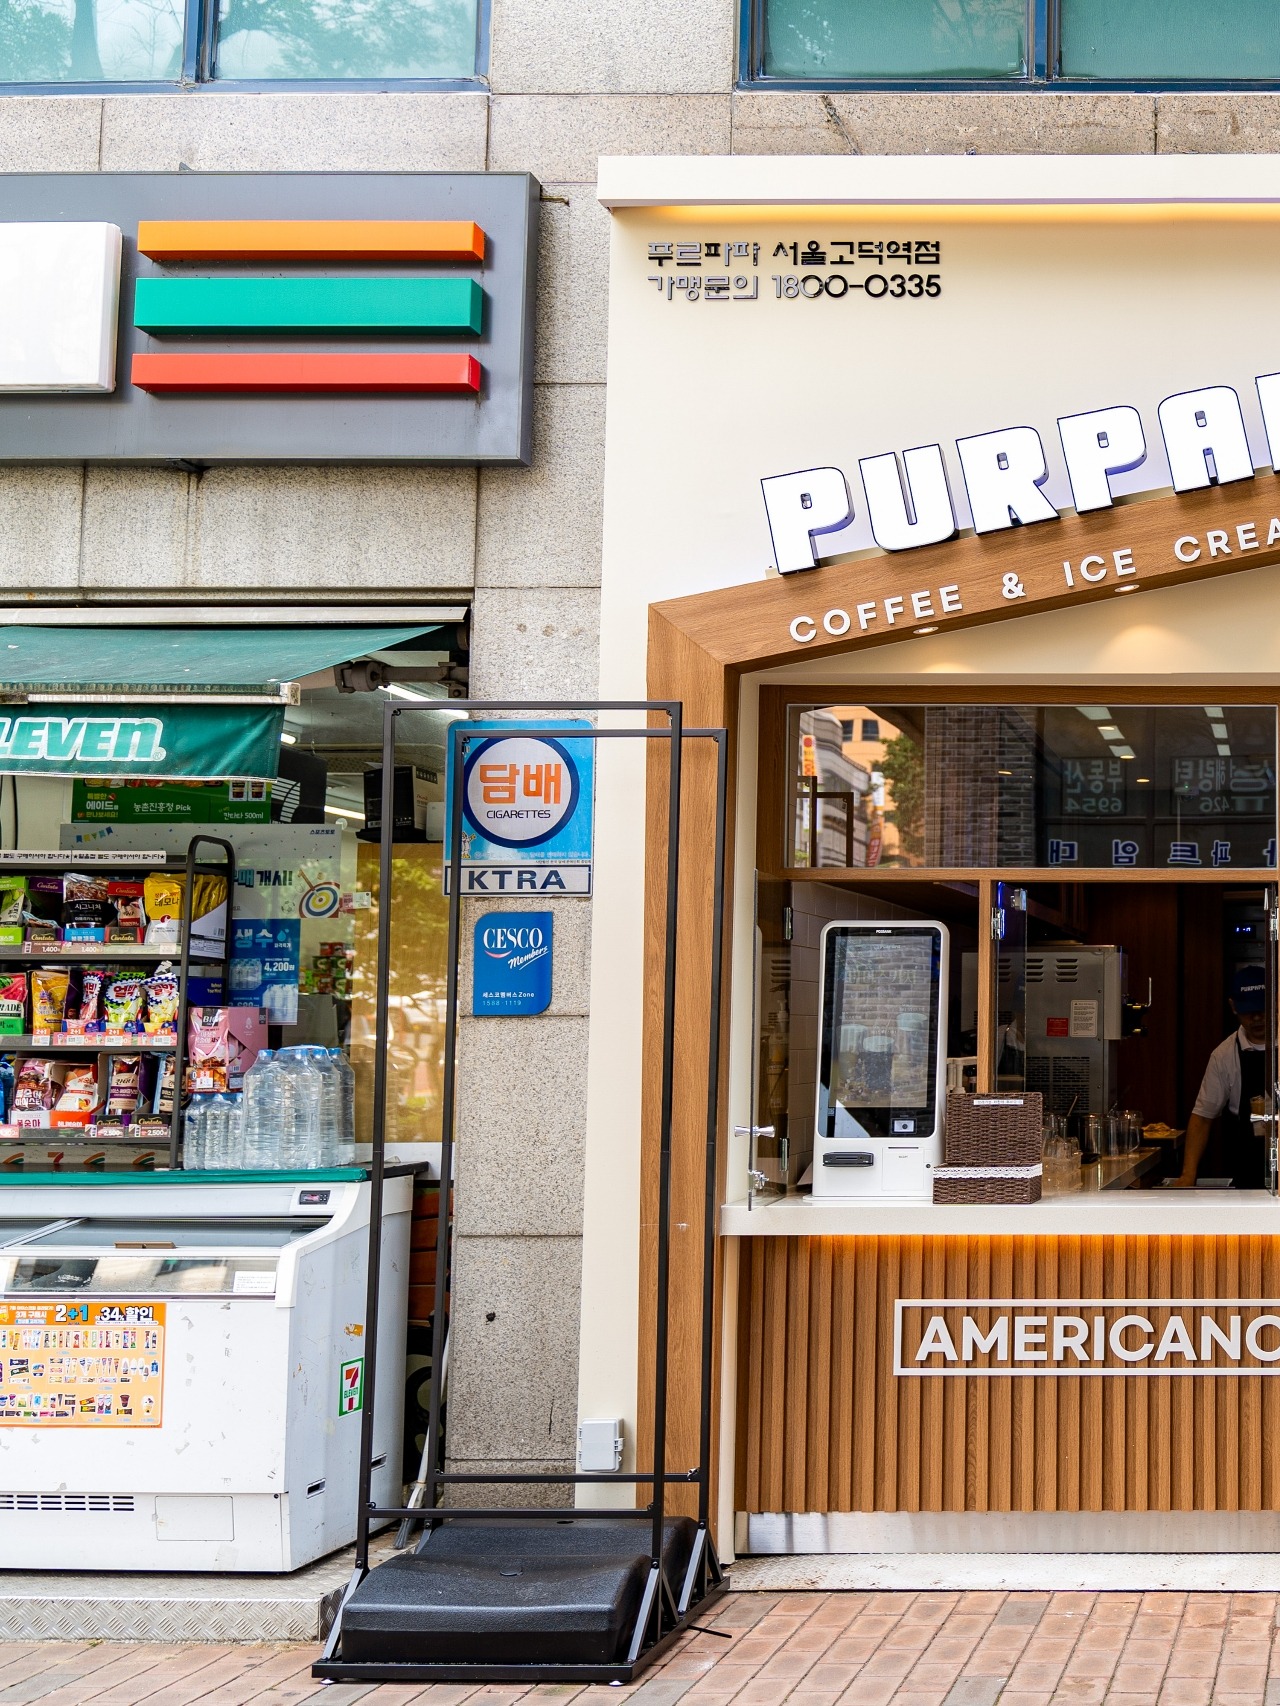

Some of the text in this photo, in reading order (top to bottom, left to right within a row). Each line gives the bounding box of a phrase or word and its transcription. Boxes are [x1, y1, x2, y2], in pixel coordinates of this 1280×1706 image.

[648, 240, 941, 266] 푸르파파 서울고덕역점
[648, 274, 941, 300] 가맹문의 1800-0335
[789, 584, 963, 643] COFFEE
[1001, 572, 1026, 600] &
[1064, 549, 1137, 587] ICE
[479, 763, 562, 805] 담배
[133, 803, 192, 812] 농촌진흥청 Pick
[244, 811, 264, 819] 500ml
[486, 809, 551, 819] CIGARETTES
[468, 870, 567, 890] KTRA
[154, 898, 180, 907] 레모나
[110, 933, 134, 941] Cantata
[235, 928, 274, 949] 생수
[483, 928, 544, 949] CESCO
[507, 944, 550, 969] Members
[518, 991, 535, 999] Zone
[17, 1119, 41, 1128] 복숭아
[55, 1304, 89, 1322] 2+1
[125, 1306, 154, 1321] 할인
